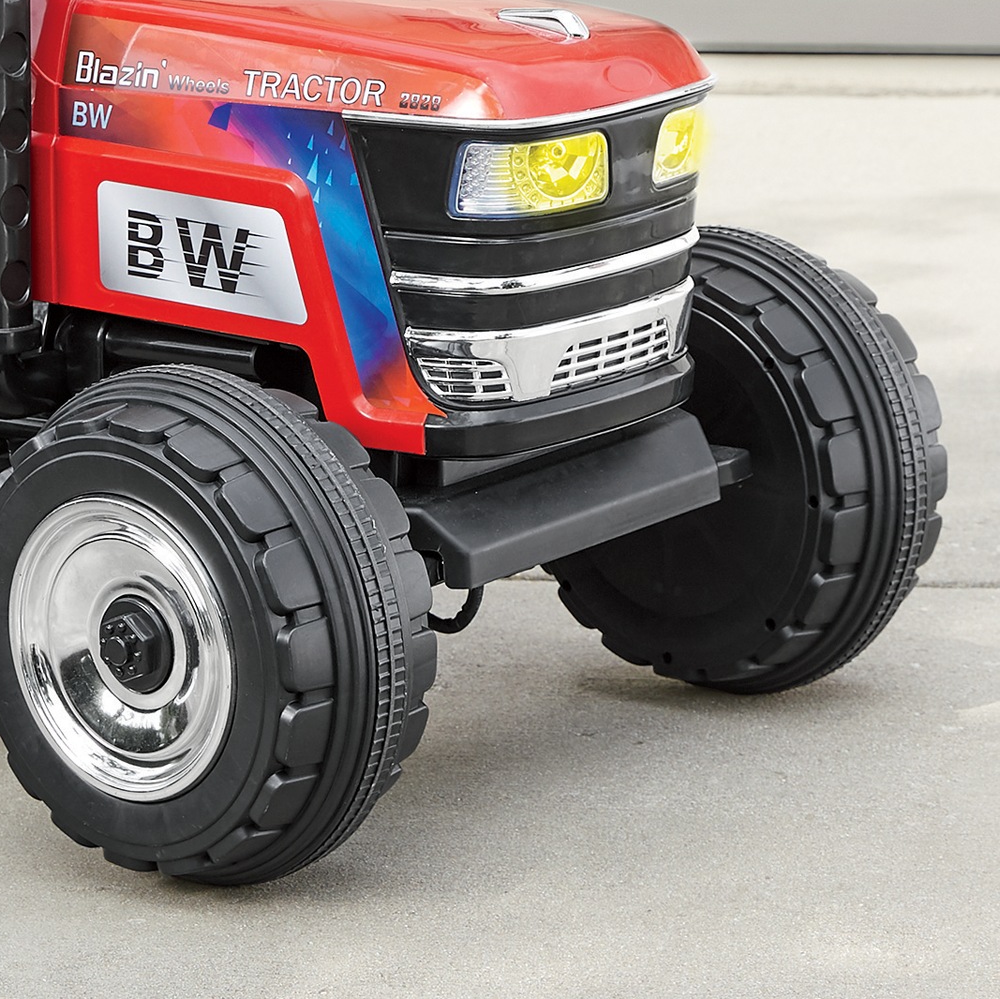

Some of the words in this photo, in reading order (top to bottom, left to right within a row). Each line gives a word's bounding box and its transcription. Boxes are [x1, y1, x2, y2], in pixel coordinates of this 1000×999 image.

[168, 74, 230, 95] Wheels
[243, 68, 386, 107] TRACTOR
[72, 100, 113, 130] BW
[127, 209, 252, 295] BW
